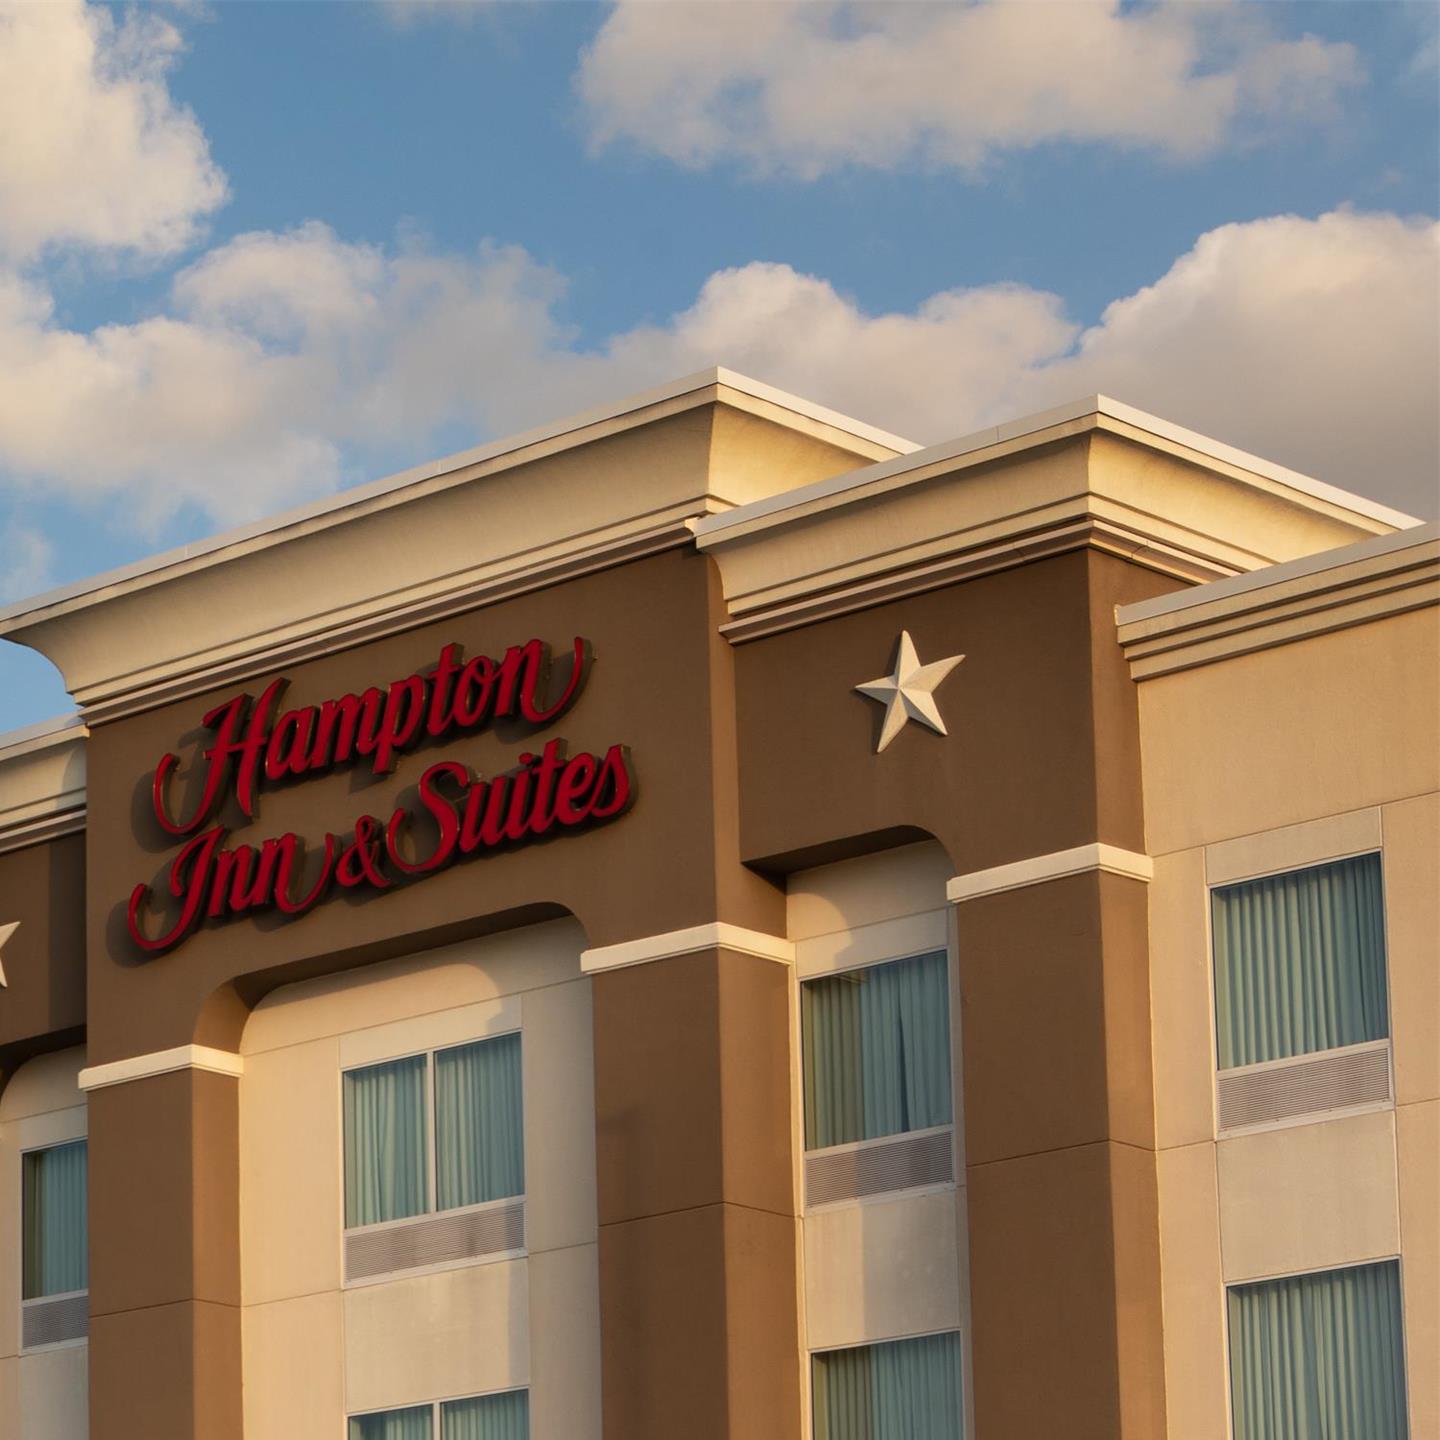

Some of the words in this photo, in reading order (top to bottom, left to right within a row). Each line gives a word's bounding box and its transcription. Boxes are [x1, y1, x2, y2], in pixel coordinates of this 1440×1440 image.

[153, 636, 594, 834] Hampton
[127, 827, 335, 950] Inn
[336, 815, 390, 888] &
[386, 738, 631, 874] Suites
